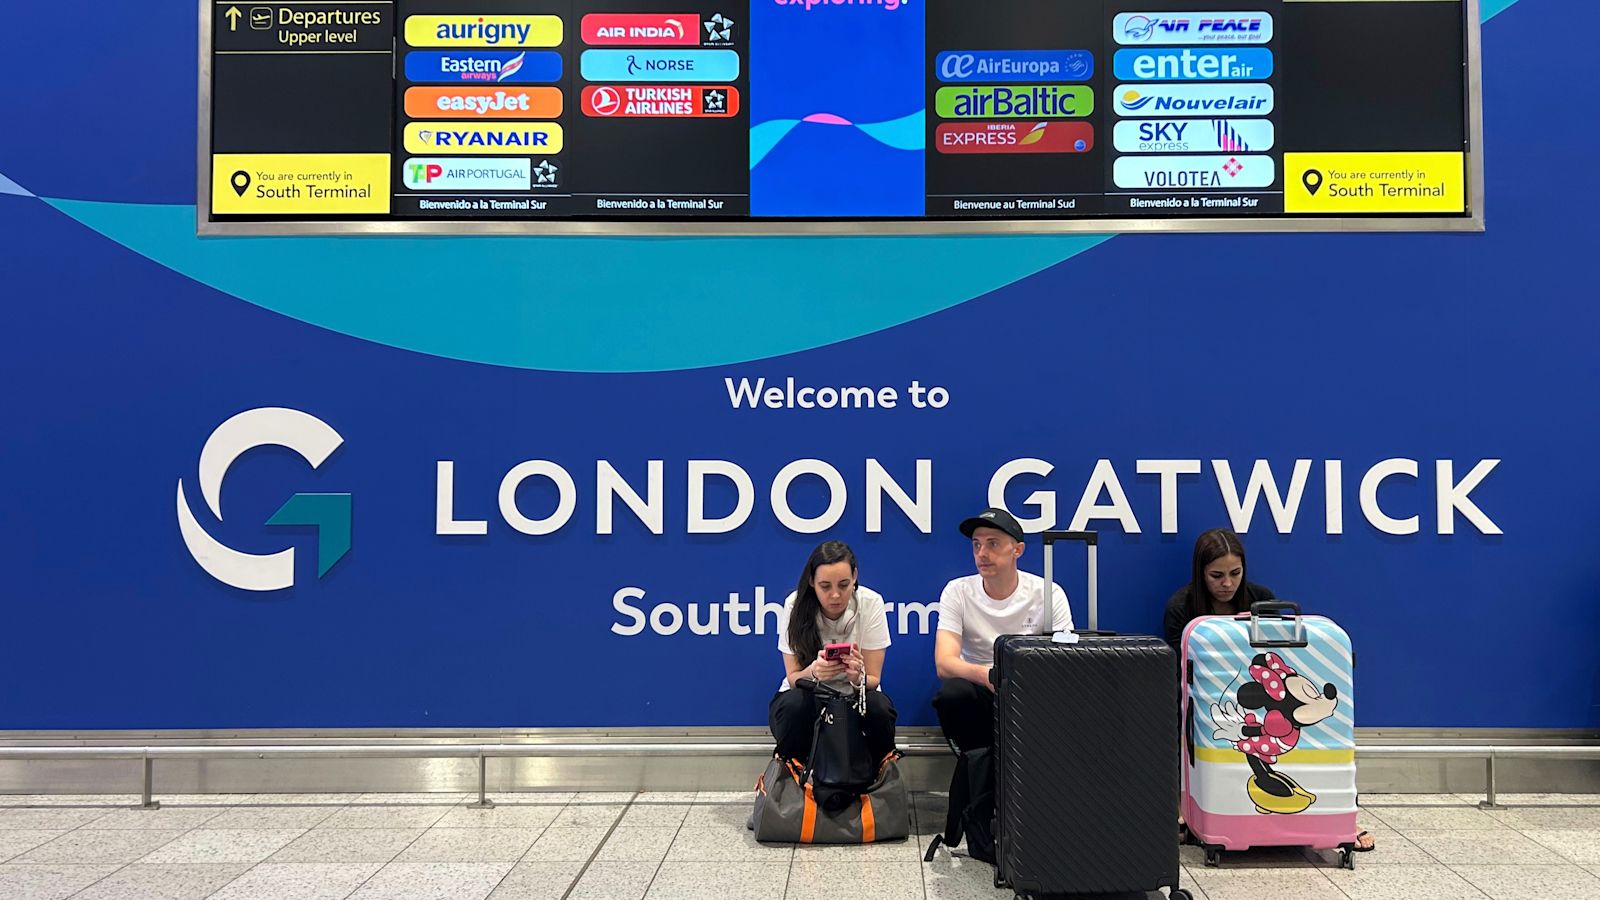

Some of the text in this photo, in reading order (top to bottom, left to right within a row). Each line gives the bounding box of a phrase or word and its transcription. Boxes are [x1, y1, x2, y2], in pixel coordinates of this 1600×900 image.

[278, 8, 381, 27] Departures
[1198, 19, 1261, 31] PEACE
[278, 30, 356, 46] Upper level
[437, 18, 530, 43] aurigny
[597, 27, 675, 37] AIR INDIA
[441, 57, 500, 72] Eastern
[646, 59, 694, 70] NORSE
[976, 58, 1059, 75] AirEuropa
[1133, 49, 1253, 78] enter air
[461, 72, 497, 81] airways
[625, 88, 692, 101] TURKISH
[954, 88, 1075, 115] airBaltic
[437, 91, 530, 115] easyJet
[625, 102, 692, 115] AIRLINES
[1155, 95, 1266, 110] Nouvelair
[436, 131, 548, 146] RYANAIR
[943, 133, 1017, 145] EXPRESS
[1139, 123, 1188, 141] SKY
[1139, 141, 1189, 151] express
[256, 170, 353, 183] You are currently in
[1144, 171, 1221, 186] VOLOTEA
[1328, 169, 1425, 181] You are currently in
[256, 184, 371, 199] South Terminal
[1329, 183, 1445, 197] South Terminal
[420, 200, 471, 209] Bienvenido
[480, 200, 488, 209] la
[489, 200, 529, 209] Terminal
[530, 200, 546, 209] Sur
[597, 199, 724, 209] Bienvenido a la Terminal Sur
[954, 199, 1075, 210] Bienvenue au Terminal Sud
[1130, 197, 1258, 208] Bienvenido a la Terminal Sur
[725, 377, 950, 408] Welcome to
[436, 457, 1504, 536] LONDON GATWICK
[611, 587, 784, 636] South
